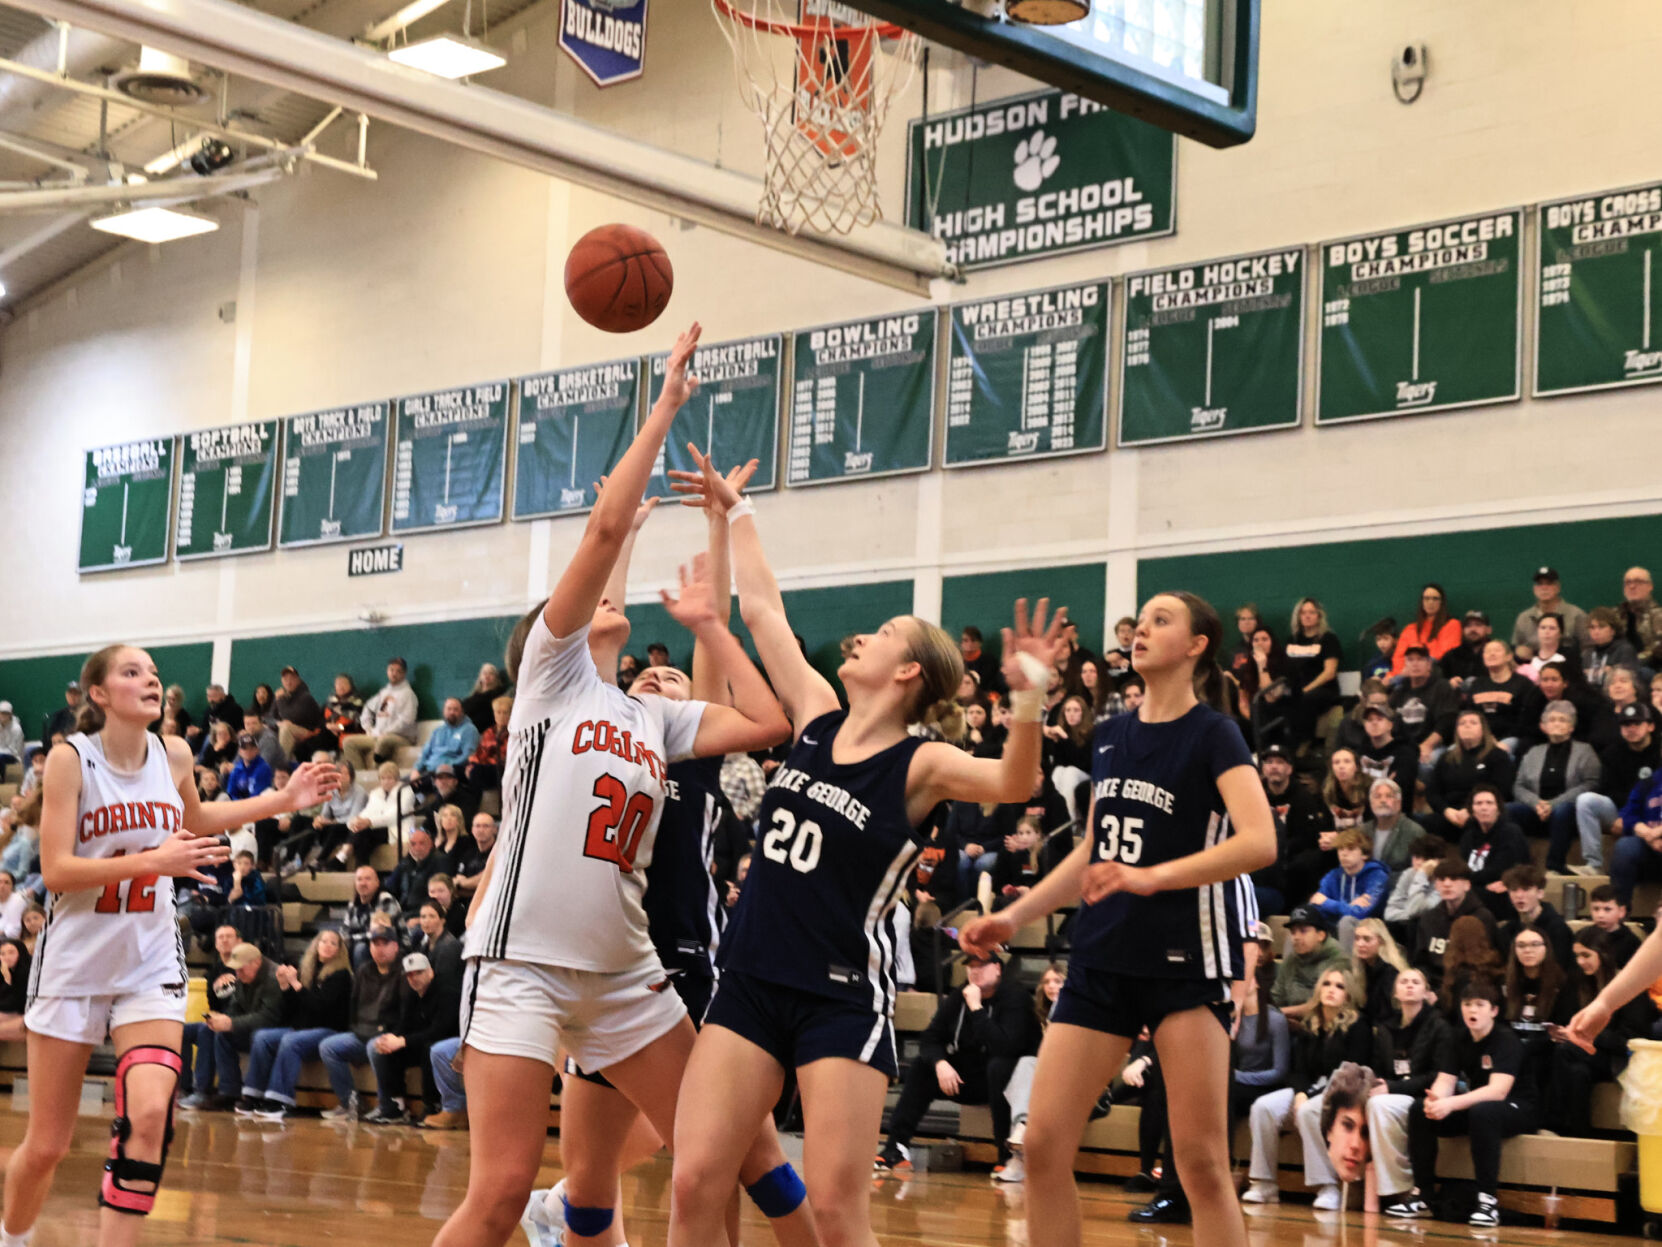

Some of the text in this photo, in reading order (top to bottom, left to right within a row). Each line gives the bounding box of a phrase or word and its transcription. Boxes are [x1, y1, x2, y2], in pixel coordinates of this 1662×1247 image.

[566, 0, 641, 60] BULLDOGS
[924, 99, 1048, 150] HUDSON
[933, 176, 1143, 240] HIGH SCHOOL
[1547, 189, 1661, 230] BOYS CROSS
[943, 202, 1152, 265] HAMPIONSHIPS
[1329, 215, 1513, 267] BOYS SOCCER
[1130, 251, 1299, 297] FIELD HOCKEY
[1351, 241, 1488, 282] CHAMPIONS
[962, 286, 1099, 326] WRESTLING
[1152, 277, 1274, 312] CHAMPIONS
[810, 314, 920, 351] BOWLING
[974, 308, 1083, 341] CHAMPIONS
[694, 339, 776, 369] BASKETBALL
[816, 334, 912, 366] CHAMPIONS
[524, 375, 555, 398] BOYS
[559, 362, 634, 391] BASKETBALL
[191, 422, 269, 451] SOFTBALL
[351, 548, 400, 574] HOME
[806, 780, 872, 832] GEORGE
[1121, 778, 1176, 816] GEORGE
[583, 771, 653, 874] 20
[763, 806, 823, 874] 20
[1098, 814, 1145, 865] 35
